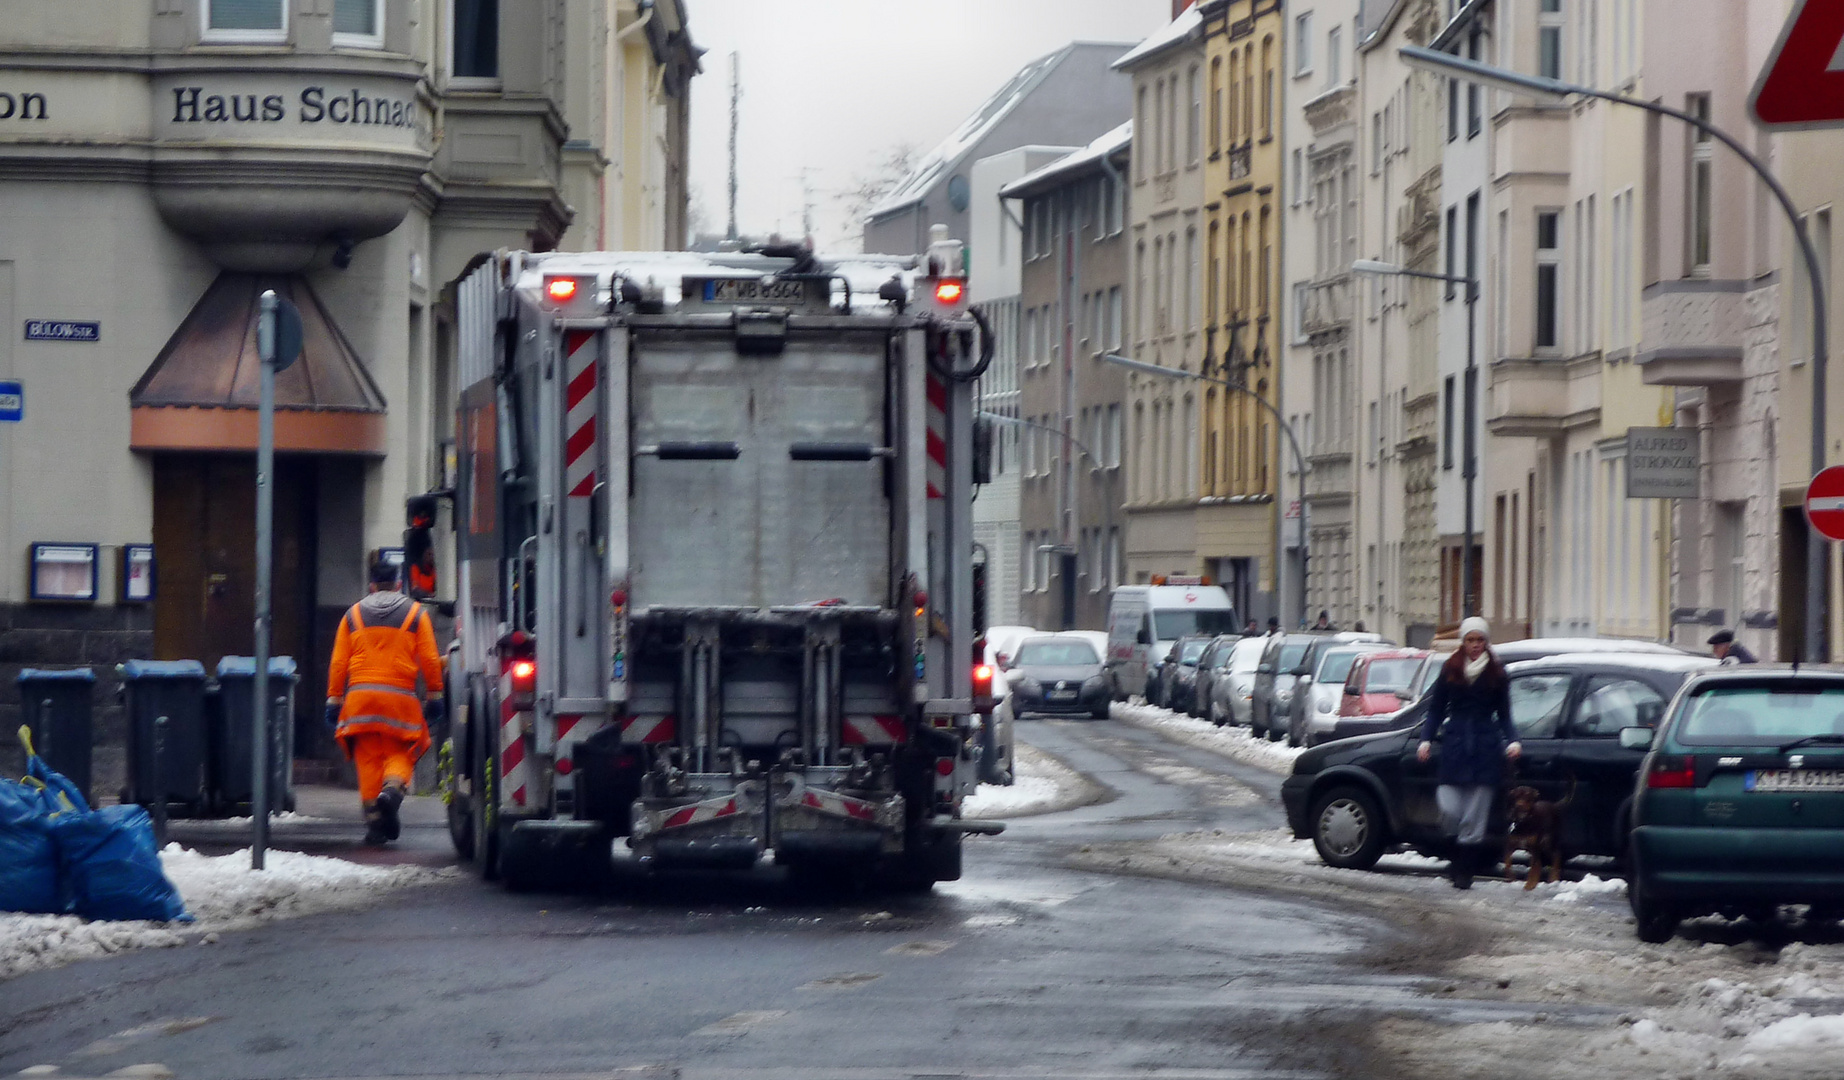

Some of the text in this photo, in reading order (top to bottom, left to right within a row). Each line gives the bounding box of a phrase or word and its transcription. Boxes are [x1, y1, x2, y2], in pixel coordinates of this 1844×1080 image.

[172, 86, 285, 122] Haus
[715, 281, 727, 298] K
[1633, 437, 1689, 451] ALFRED
